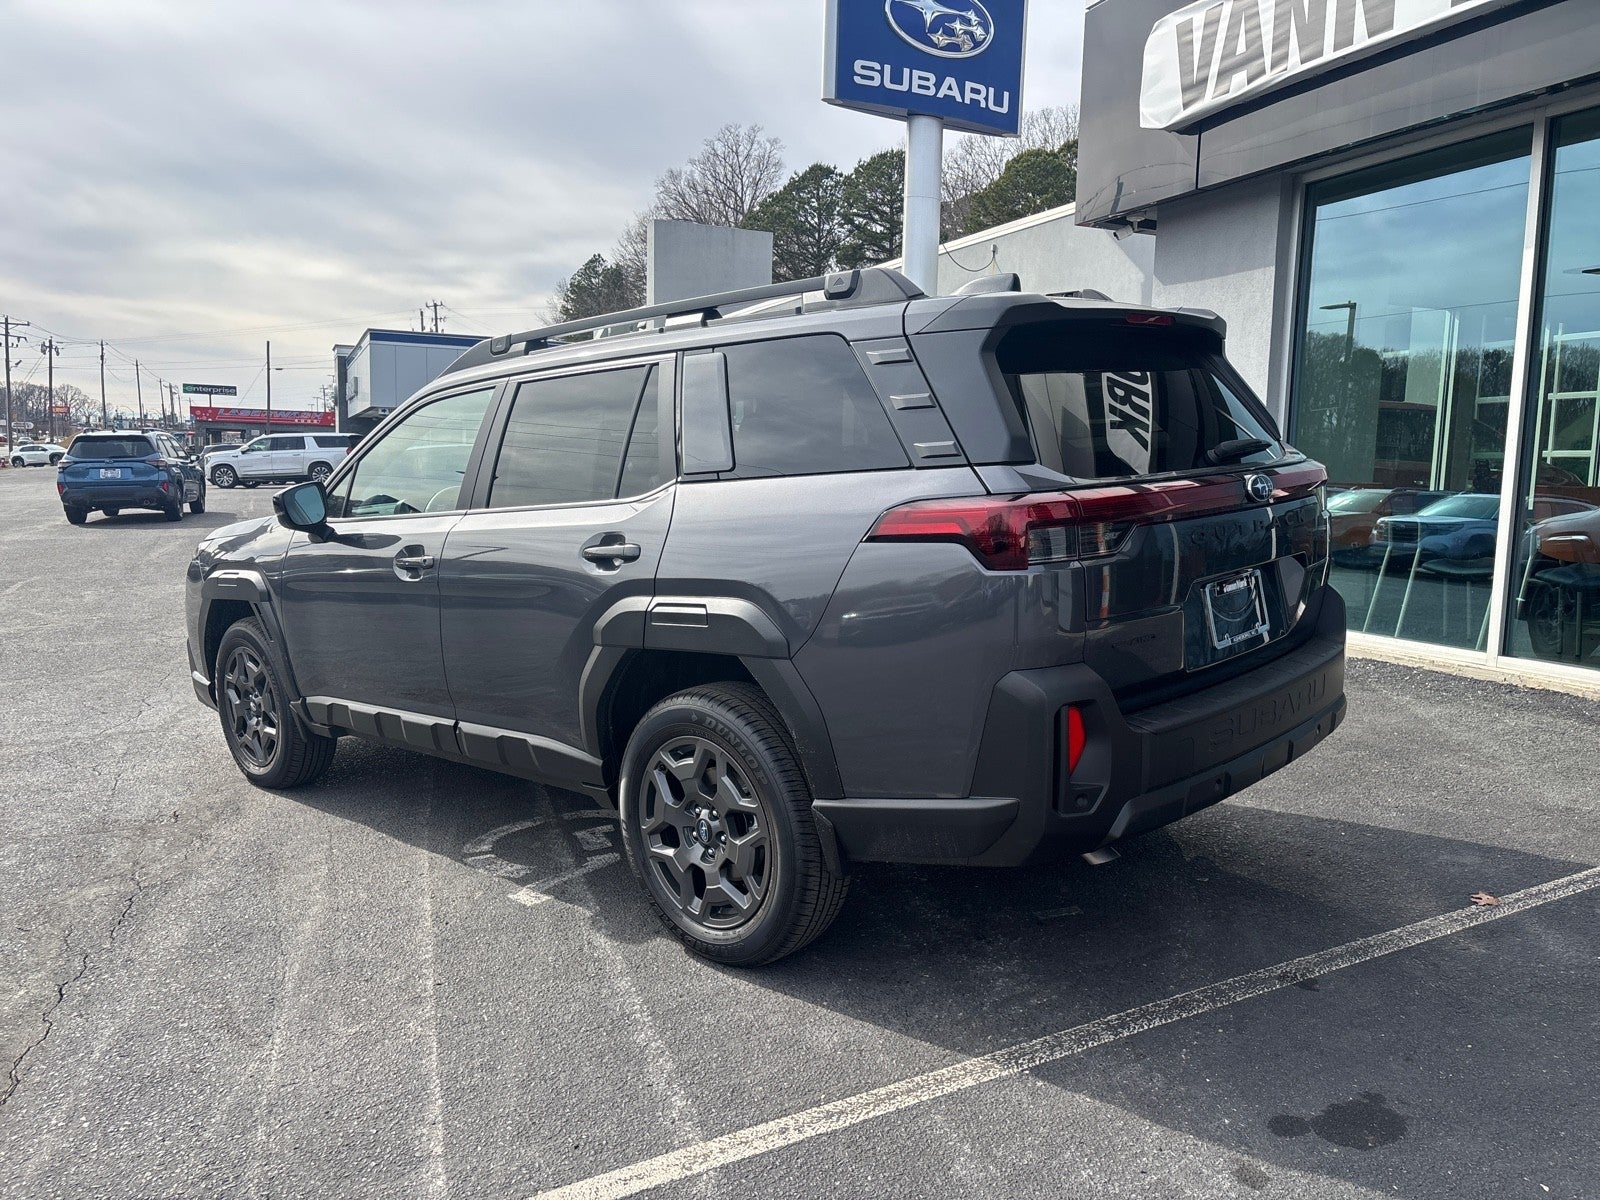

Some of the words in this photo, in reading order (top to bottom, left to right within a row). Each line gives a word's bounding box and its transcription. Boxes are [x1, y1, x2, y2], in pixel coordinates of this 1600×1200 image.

[853, 59, 1010, 114] SUBARU
[1175, 0, 1395, 111] VANN
[184, 385, 236, 395] enterprise
[1208, 672, 1326, 752] SUBARU
[704, 716, 768, 785] DUNLOP
